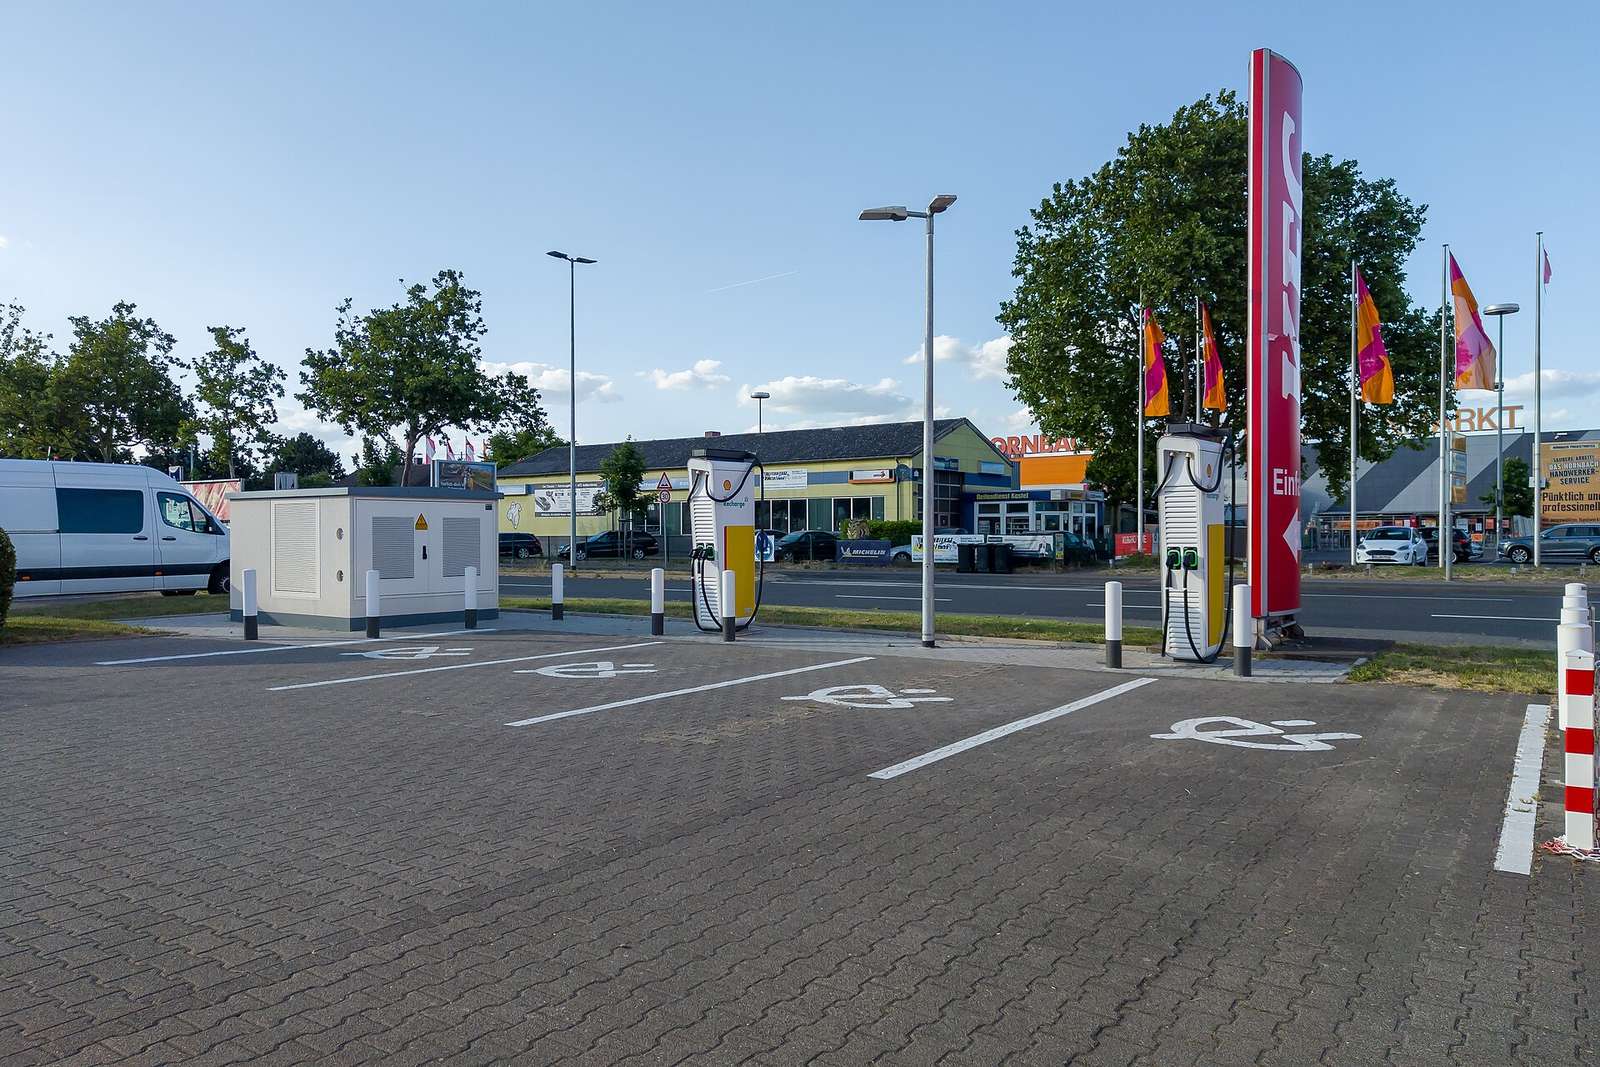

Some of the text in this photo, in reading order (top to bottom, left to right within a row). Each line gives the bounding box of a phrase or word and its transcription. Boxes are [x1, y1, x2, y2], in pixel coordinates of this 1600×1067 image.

[991, 434, 1076, 454] ORNBA
[1549, 468, 1599, 478] HANDWERKER-
[1560, 477, 1590, 485] SERVICE
[661, 492, 669, 501] 30
[1542, 491, 1584, 502] Pünktlich
[723, 500, 745, 509] Recharge
[1542, 502, 1600, 514] professionell
